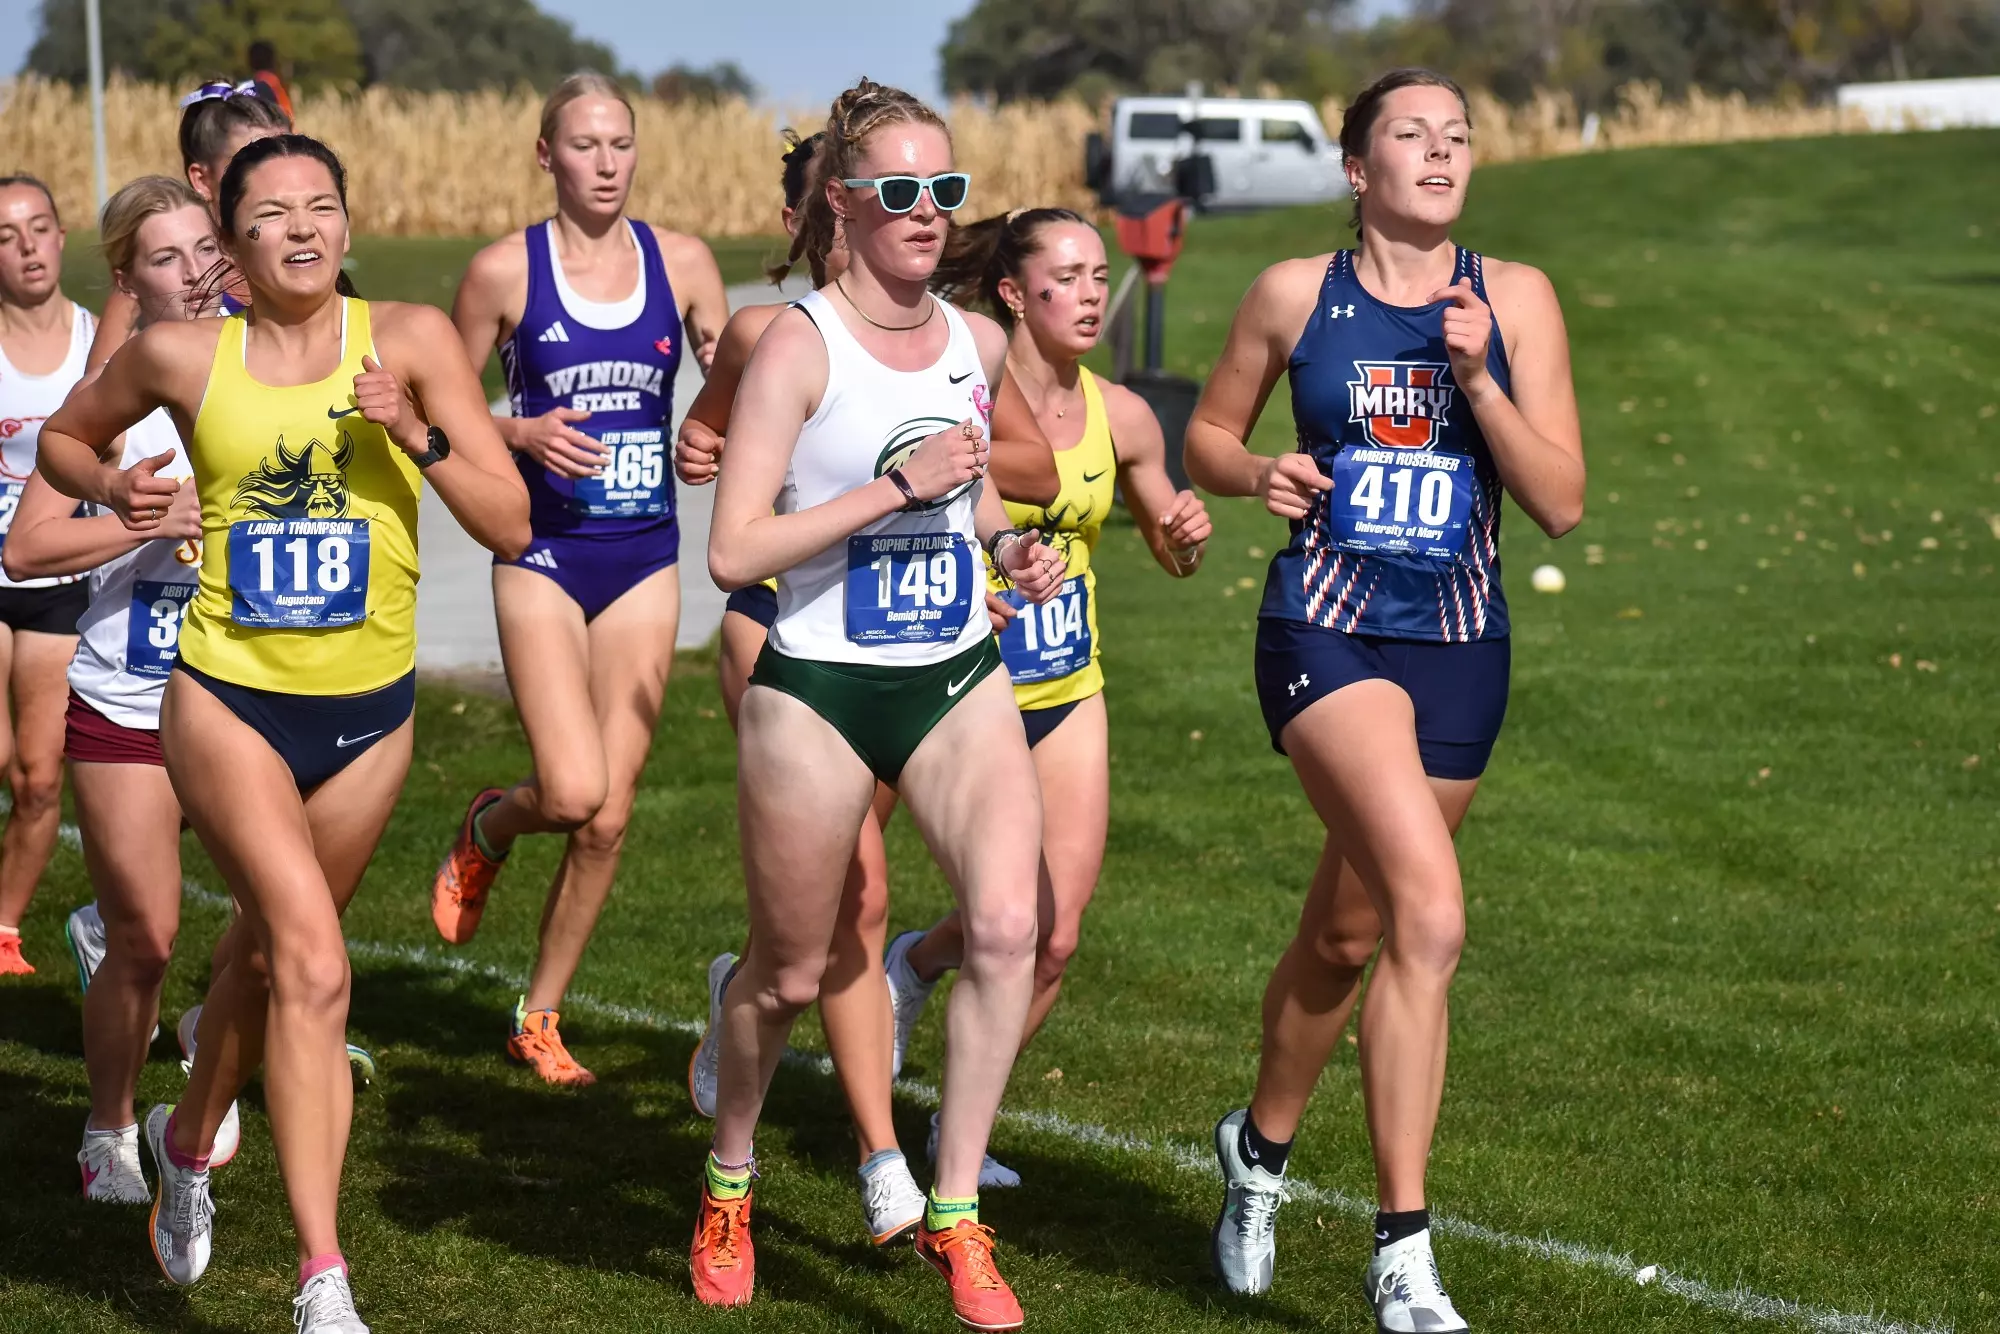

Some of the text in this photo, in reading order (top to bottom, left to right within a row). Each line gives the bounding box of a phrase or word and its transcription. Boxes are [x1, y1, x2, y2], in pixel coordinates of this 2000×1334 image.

[544, 360, 664, 398] WINONA
[572, 391, 642, 412] STATE
[1355, 385, 1449, 421] MARY
[591, 444, 664, 490] 465
[1351, 449, 1394, 464] AMBER
[1350, 465, 1453, 526] 410
[247, 522, 354, 535] LAURA THOMPSON
[1354, 521, 1444, 540] University of Mary
[871, 535, 955, 552] SOPHIE RYLANCE
[252, 536, 350, 592] 118
[870, 551, 957, 608] 149
[161, 585, 191, 598] ABBY
[275, 594, 326, 607] Augustana
[886, 609, 943, 622] Bemidji State
[1017, 593, 1082, 651] 104
